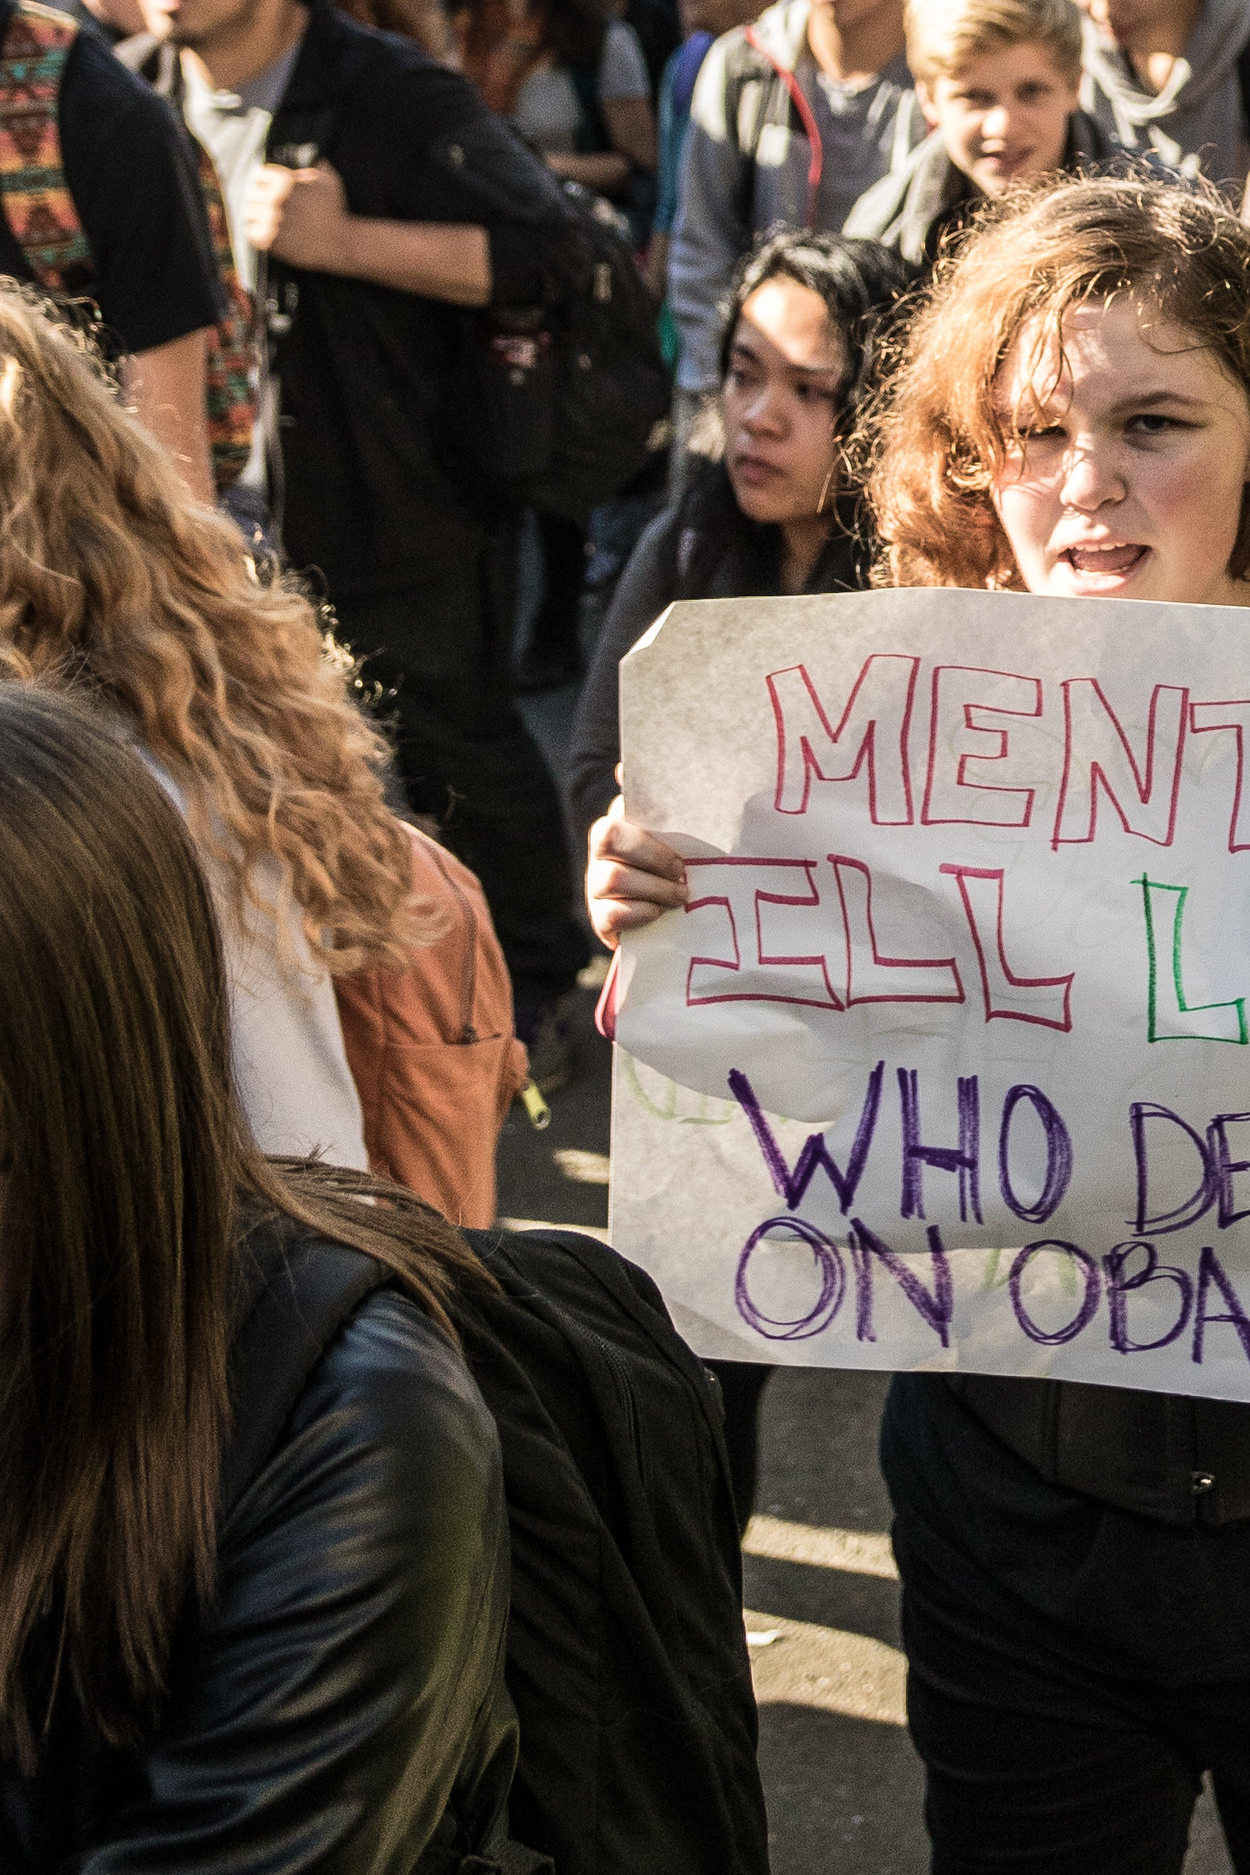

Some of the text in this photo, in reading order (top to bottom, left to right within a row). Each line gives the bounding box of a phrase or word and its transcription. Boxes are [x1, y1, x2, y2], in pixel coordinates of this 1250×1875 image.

[684, 853, 1075, 1032] ILL
[727, 1059, 1073, 1225] WHO
[734, 1215, 954, 1347] ON
